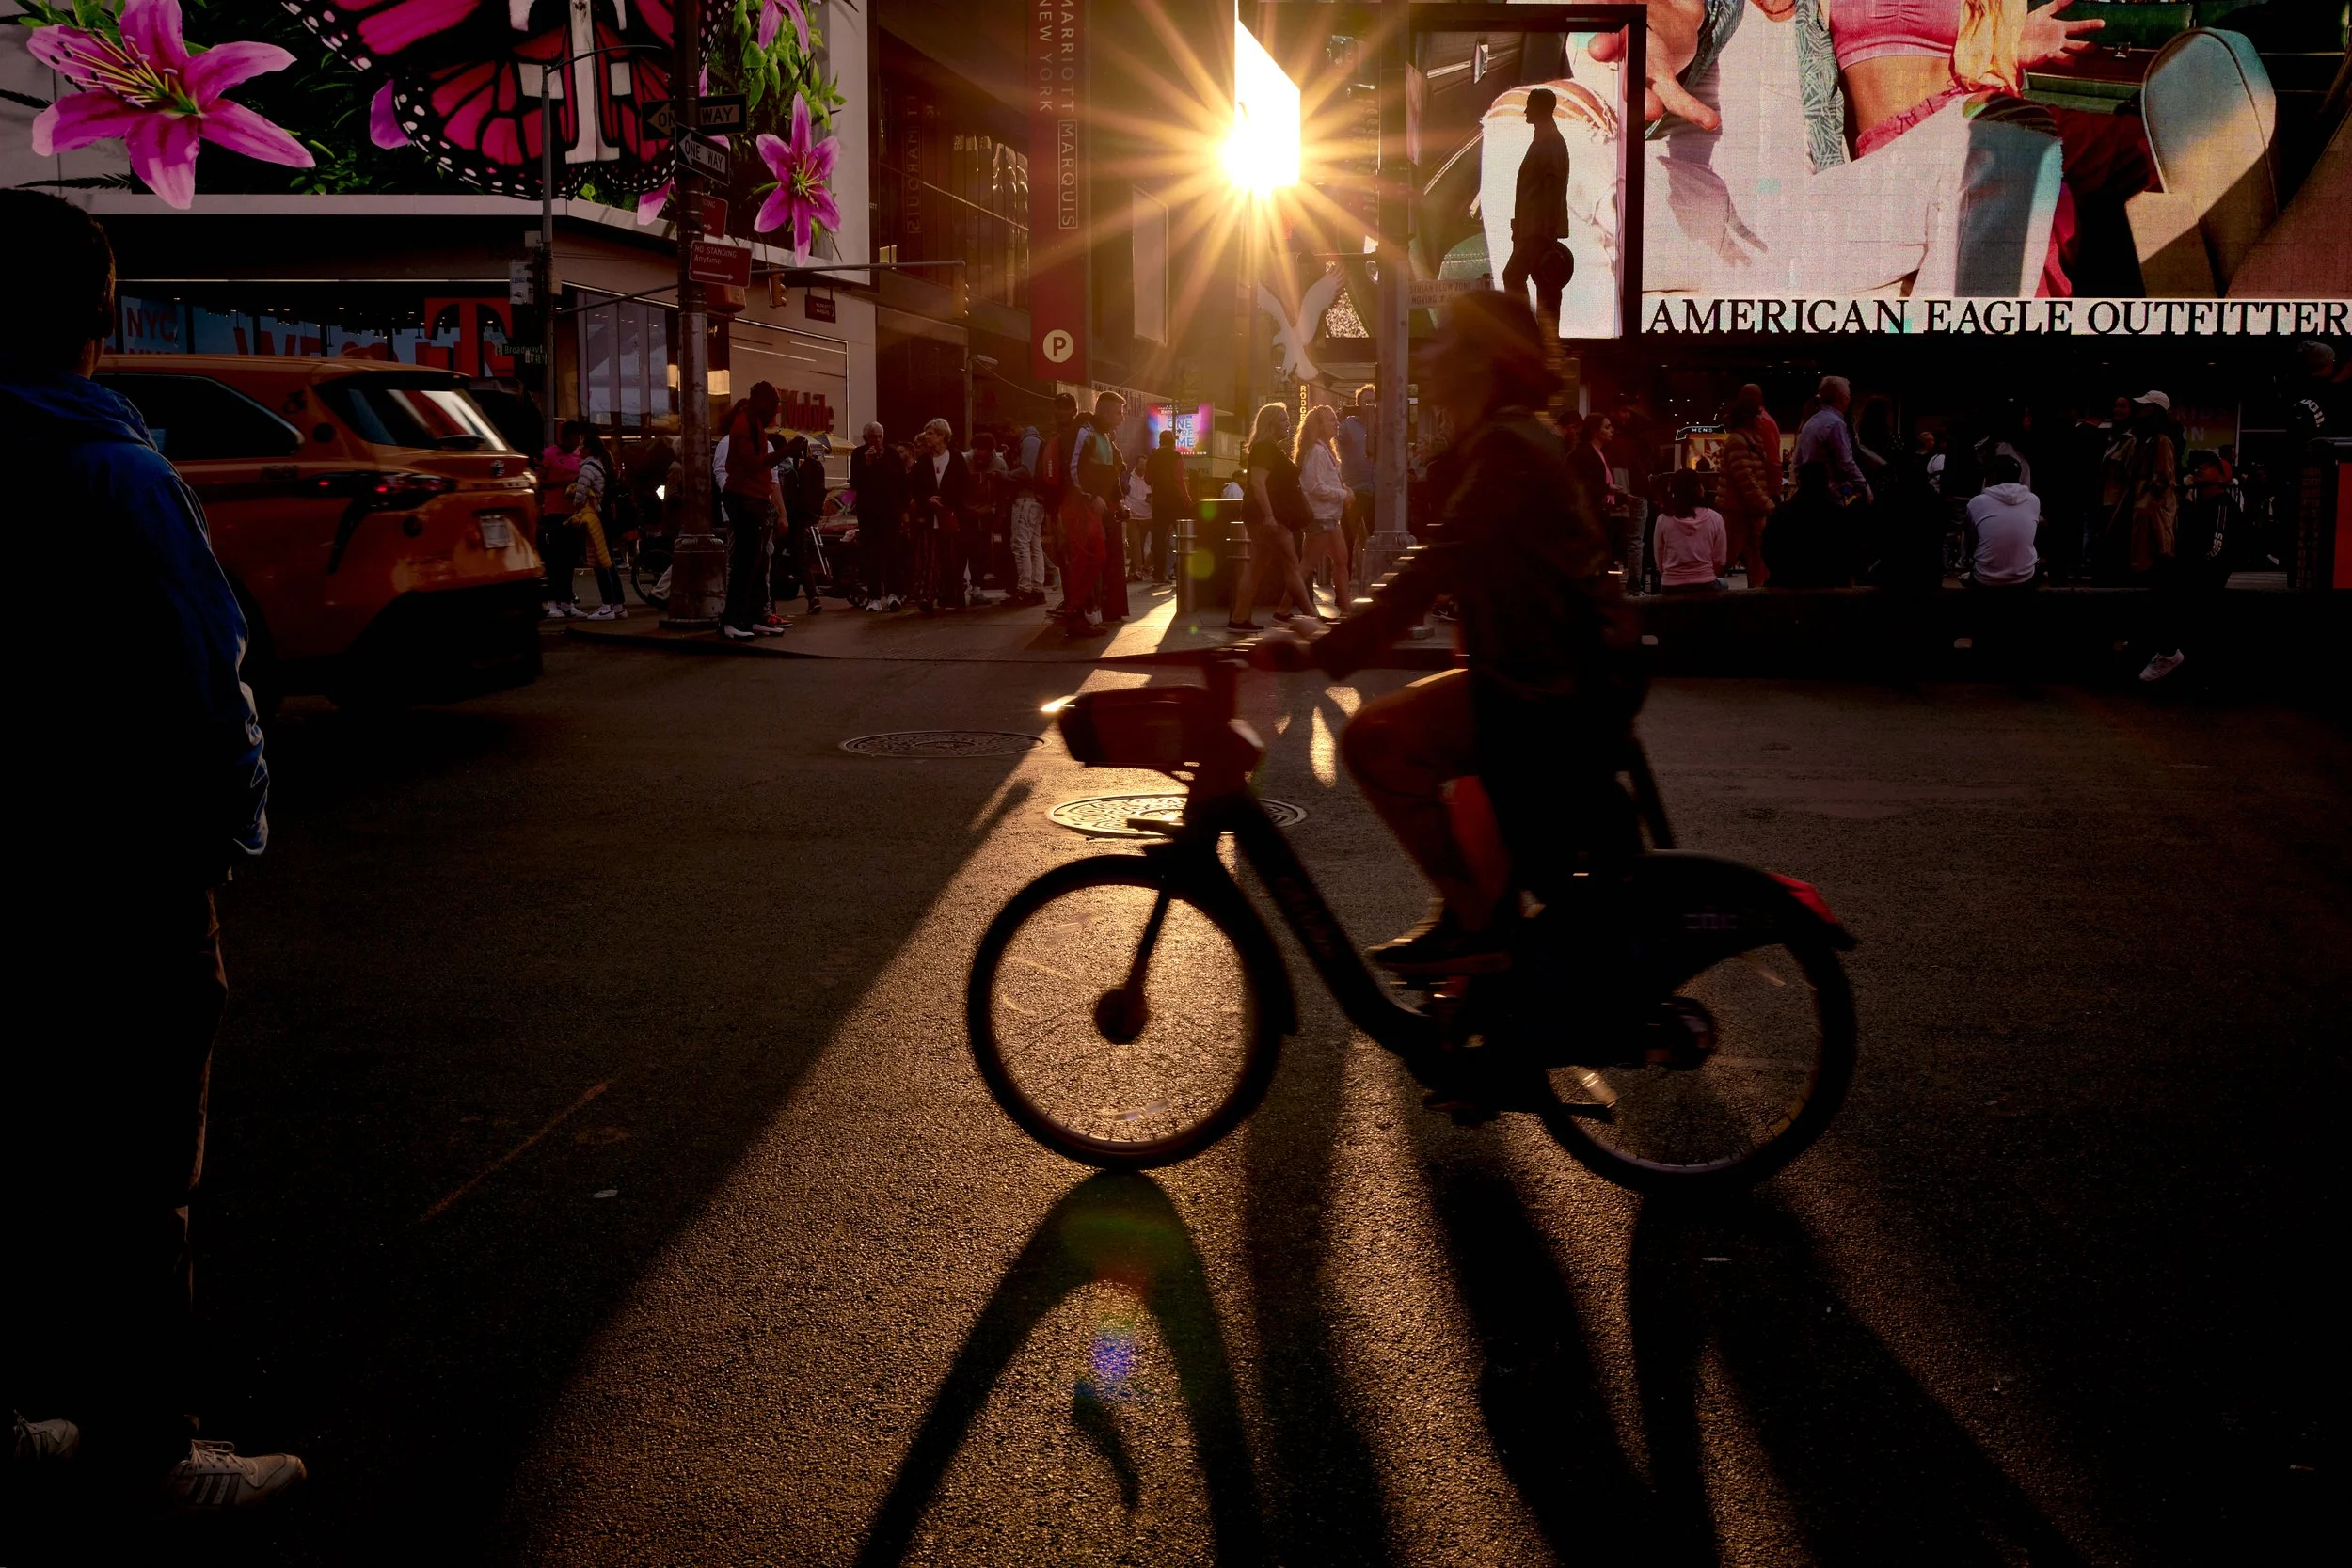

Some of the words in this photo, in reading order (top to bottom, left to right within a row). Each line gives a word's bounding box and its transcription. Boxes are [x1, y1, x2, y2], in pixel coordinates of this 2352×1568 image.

[1039, 53, 1053, 112] YORK
[659, 111, 676, 128] ON
[701, 106, 733, 124] WAY
[685, 140, 701, 160] ONE
[707, 150, 723, 170] WAY
[1061, 124, 1075, 226] MARQUIS
[693, 254, 722, 264] Anytime
[707, 246, 738, 259] STANDING
[126, 307, 176, 341] NYC
[1648, 299, 1909, 335] AMERICAN
[1924, 300, 2074, 335] EAGLE
[2087, 300, 2351, 336] OUTFITTER
[504, 344, 540, 356] Broadway
[1053, 336, 1067, 357] P
